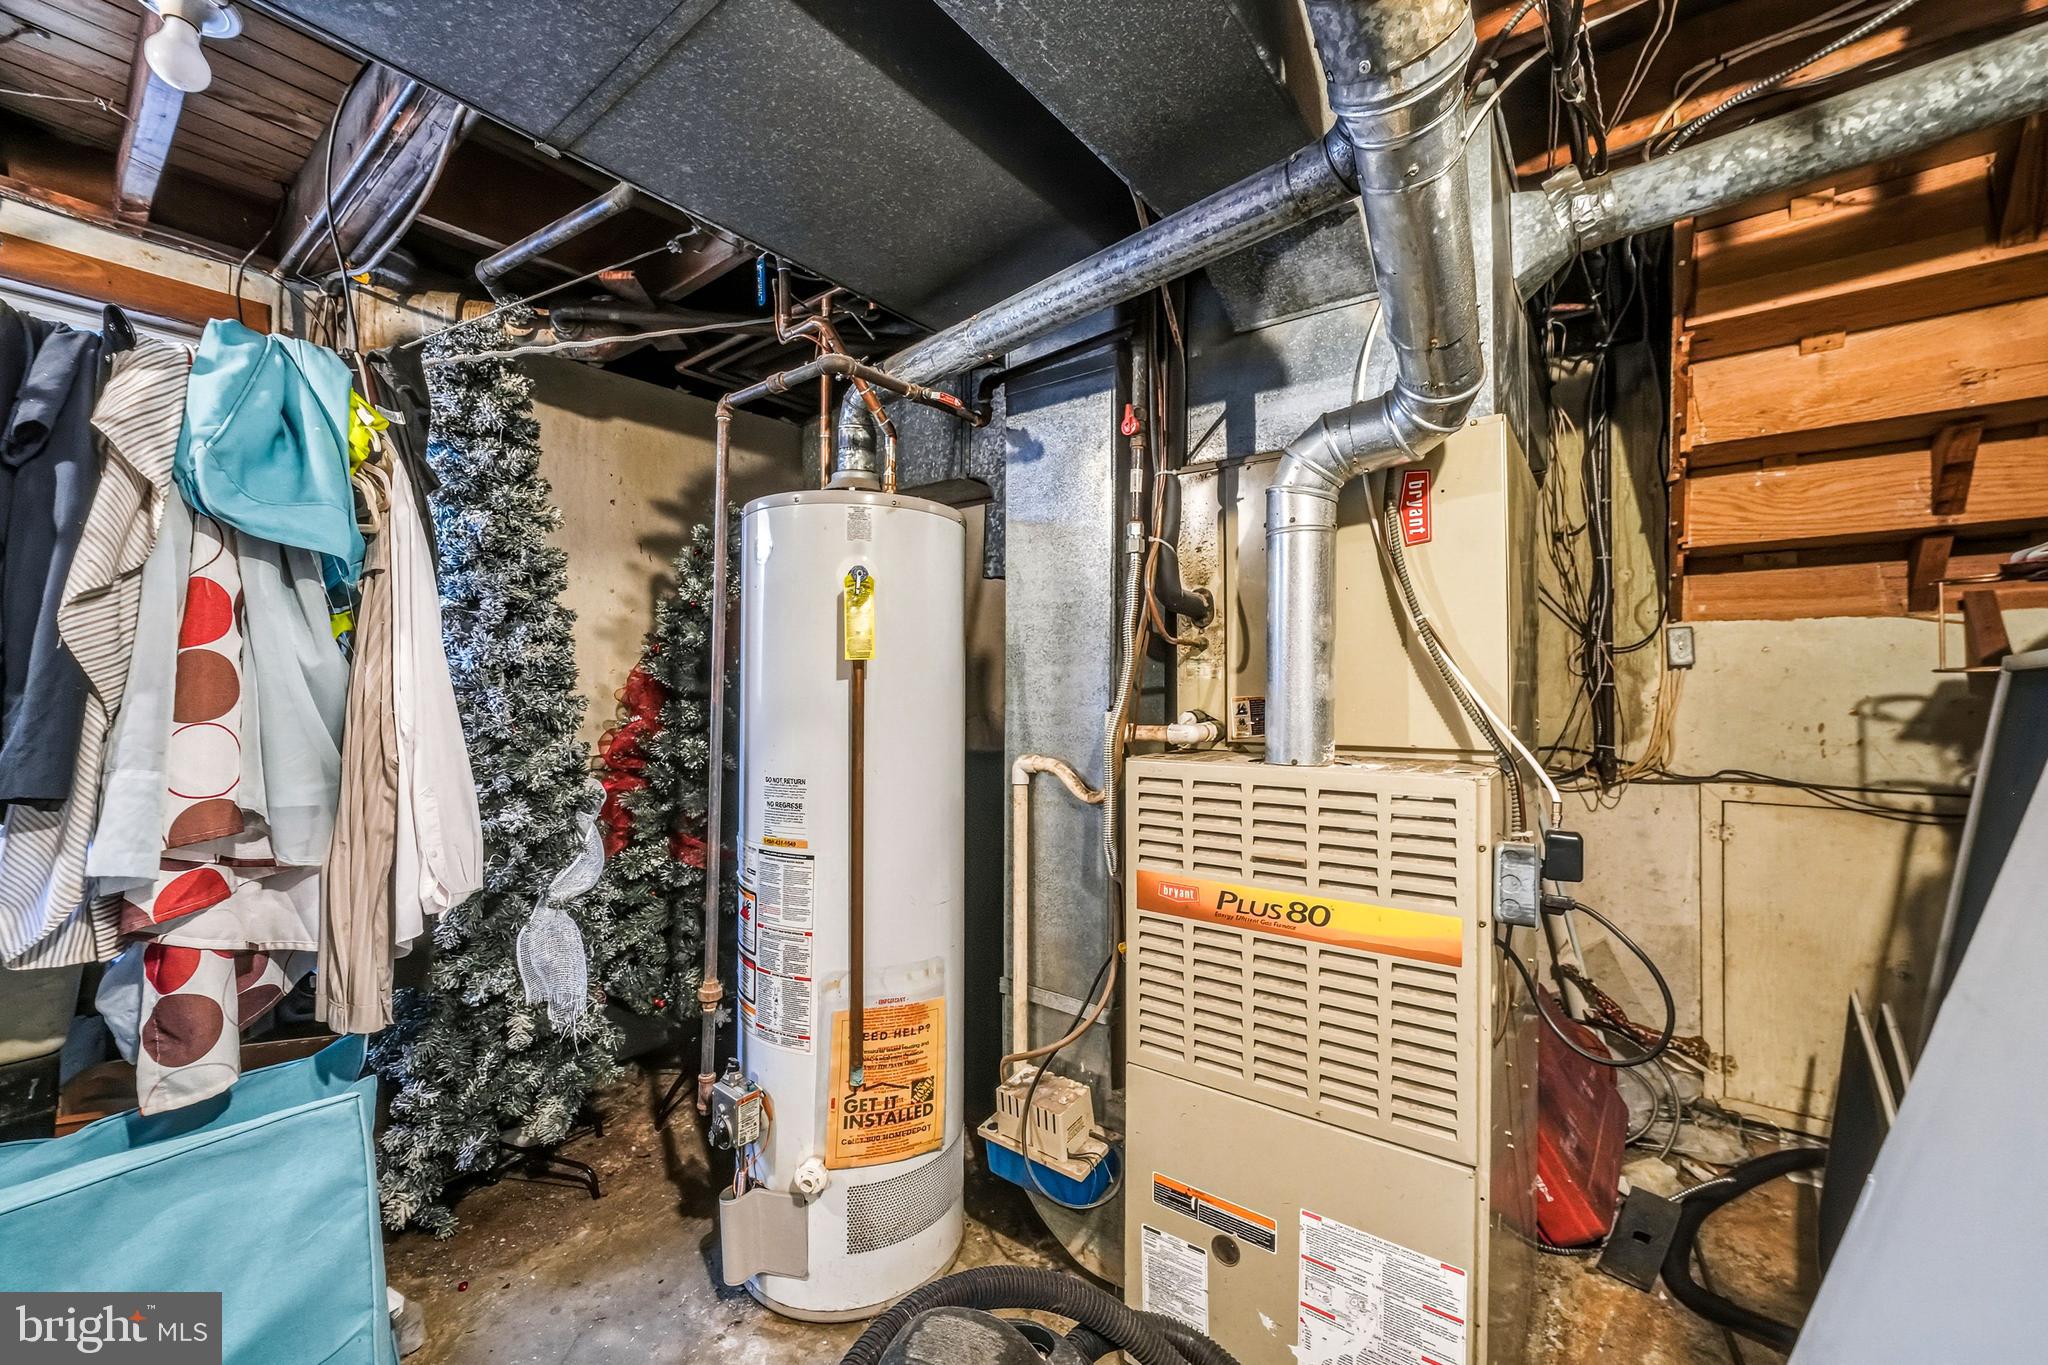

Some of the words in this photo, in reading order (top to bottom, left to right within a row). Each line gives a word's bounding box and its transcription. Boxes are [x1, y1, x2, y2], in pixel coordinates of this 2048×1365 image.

[1406, 480, 1425, 535] bryant
[775, 801, 803, 810] REGRESE
[1163, 884, 1194, 900] bryant
[1214, 911, 1234, 920] Energy
[1260, 919, 1272, 927] Gas
[1273, 921, 1297, 931] Furnace
[861, 1031, 888, 1041] EED
[893, 1023, 931, 1039] HELP?
[843, 1098, 878, 1113] GET
[884, 1095, 899, 1110] IT
[843, 1103, 934, 1129] INSTALLED
